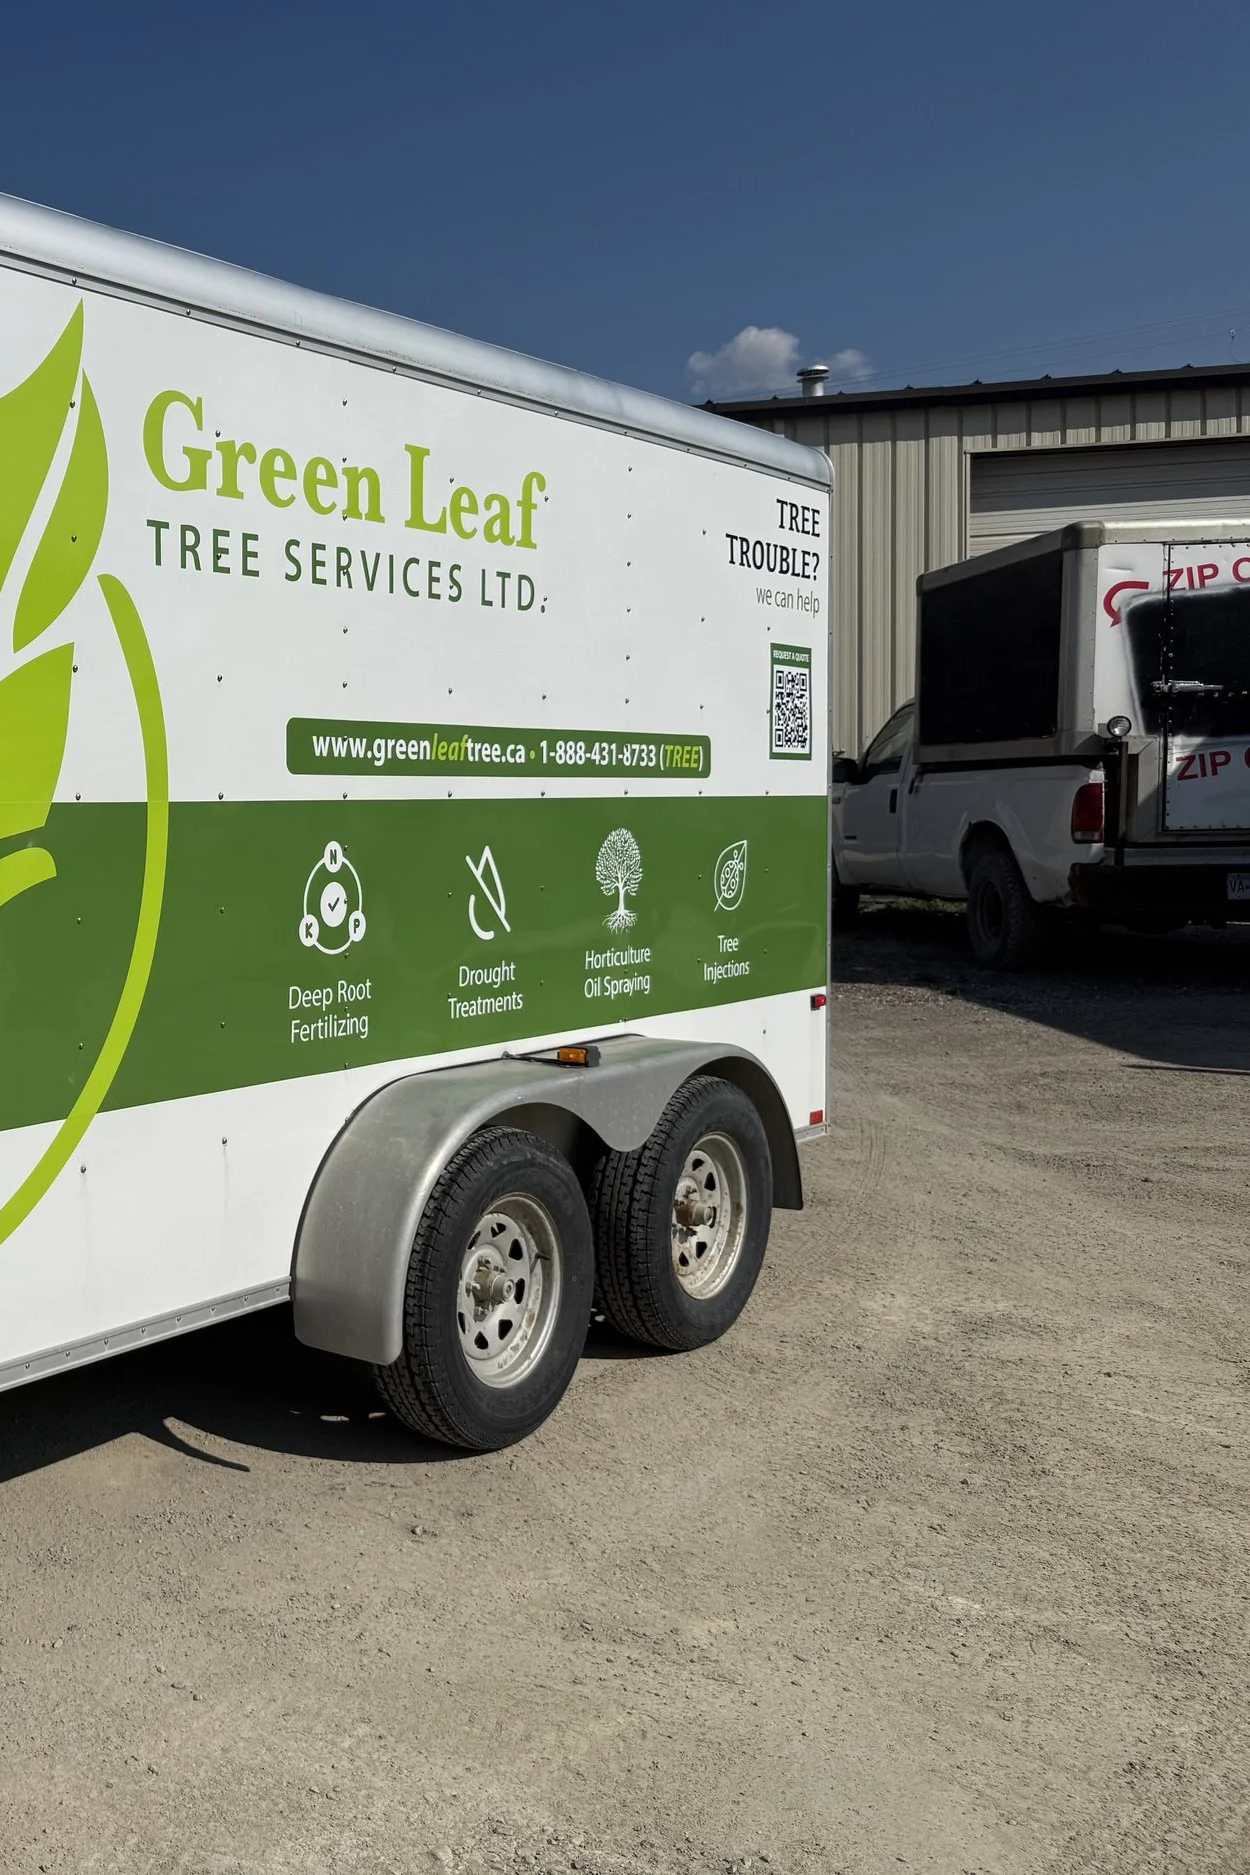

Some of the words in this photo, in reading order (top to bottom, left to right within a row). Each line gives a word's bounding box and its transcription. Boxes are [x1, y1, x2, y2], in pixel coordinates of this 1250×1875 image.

[142, 389, 386, 525] Green
[404, 443, 547, 550] Leaf
[776, 498, 821, 538] TREE
[146, 518, 260, 578] TREE
[284, 538, 463, 603] SERVICES
[480, 568, 547, 614] LTD.
[725, 532, 820, 581] TROUBLE?
[1162, 563, 1219, 592] ZIP
[756, 587, 772, 605] we
[774, 591, 794, 609] can
[797, 588, 820, 619] help
[312, 733, 525, 767] www.greenleaftree.ca
[539, 739, 656, 767] 1-888-431-8733
[659, 743, 704, 771] (TREE)
[1175, 750, 1232, 781] ZIP
[330, 849, 337, 865] N
[305, 922, 313, 939] K
[353, 918, 360, 934] P
[585, 945, 651, 970] Horticulture
[717, 934, 739, 953] Tree
[458, 960, 516, 988] Drought
[584, 976, 601, 998] Oil
[603, 972, 650, 1000] Spraying
[703, 959, 750, 984] Injections
[288, 985, 333, 1011] Deep
[337, 978, 372, 1003] Root
[448, 991, 523, 1020] Treatments
[290, 1013, 369, 1044] Fertilizing
